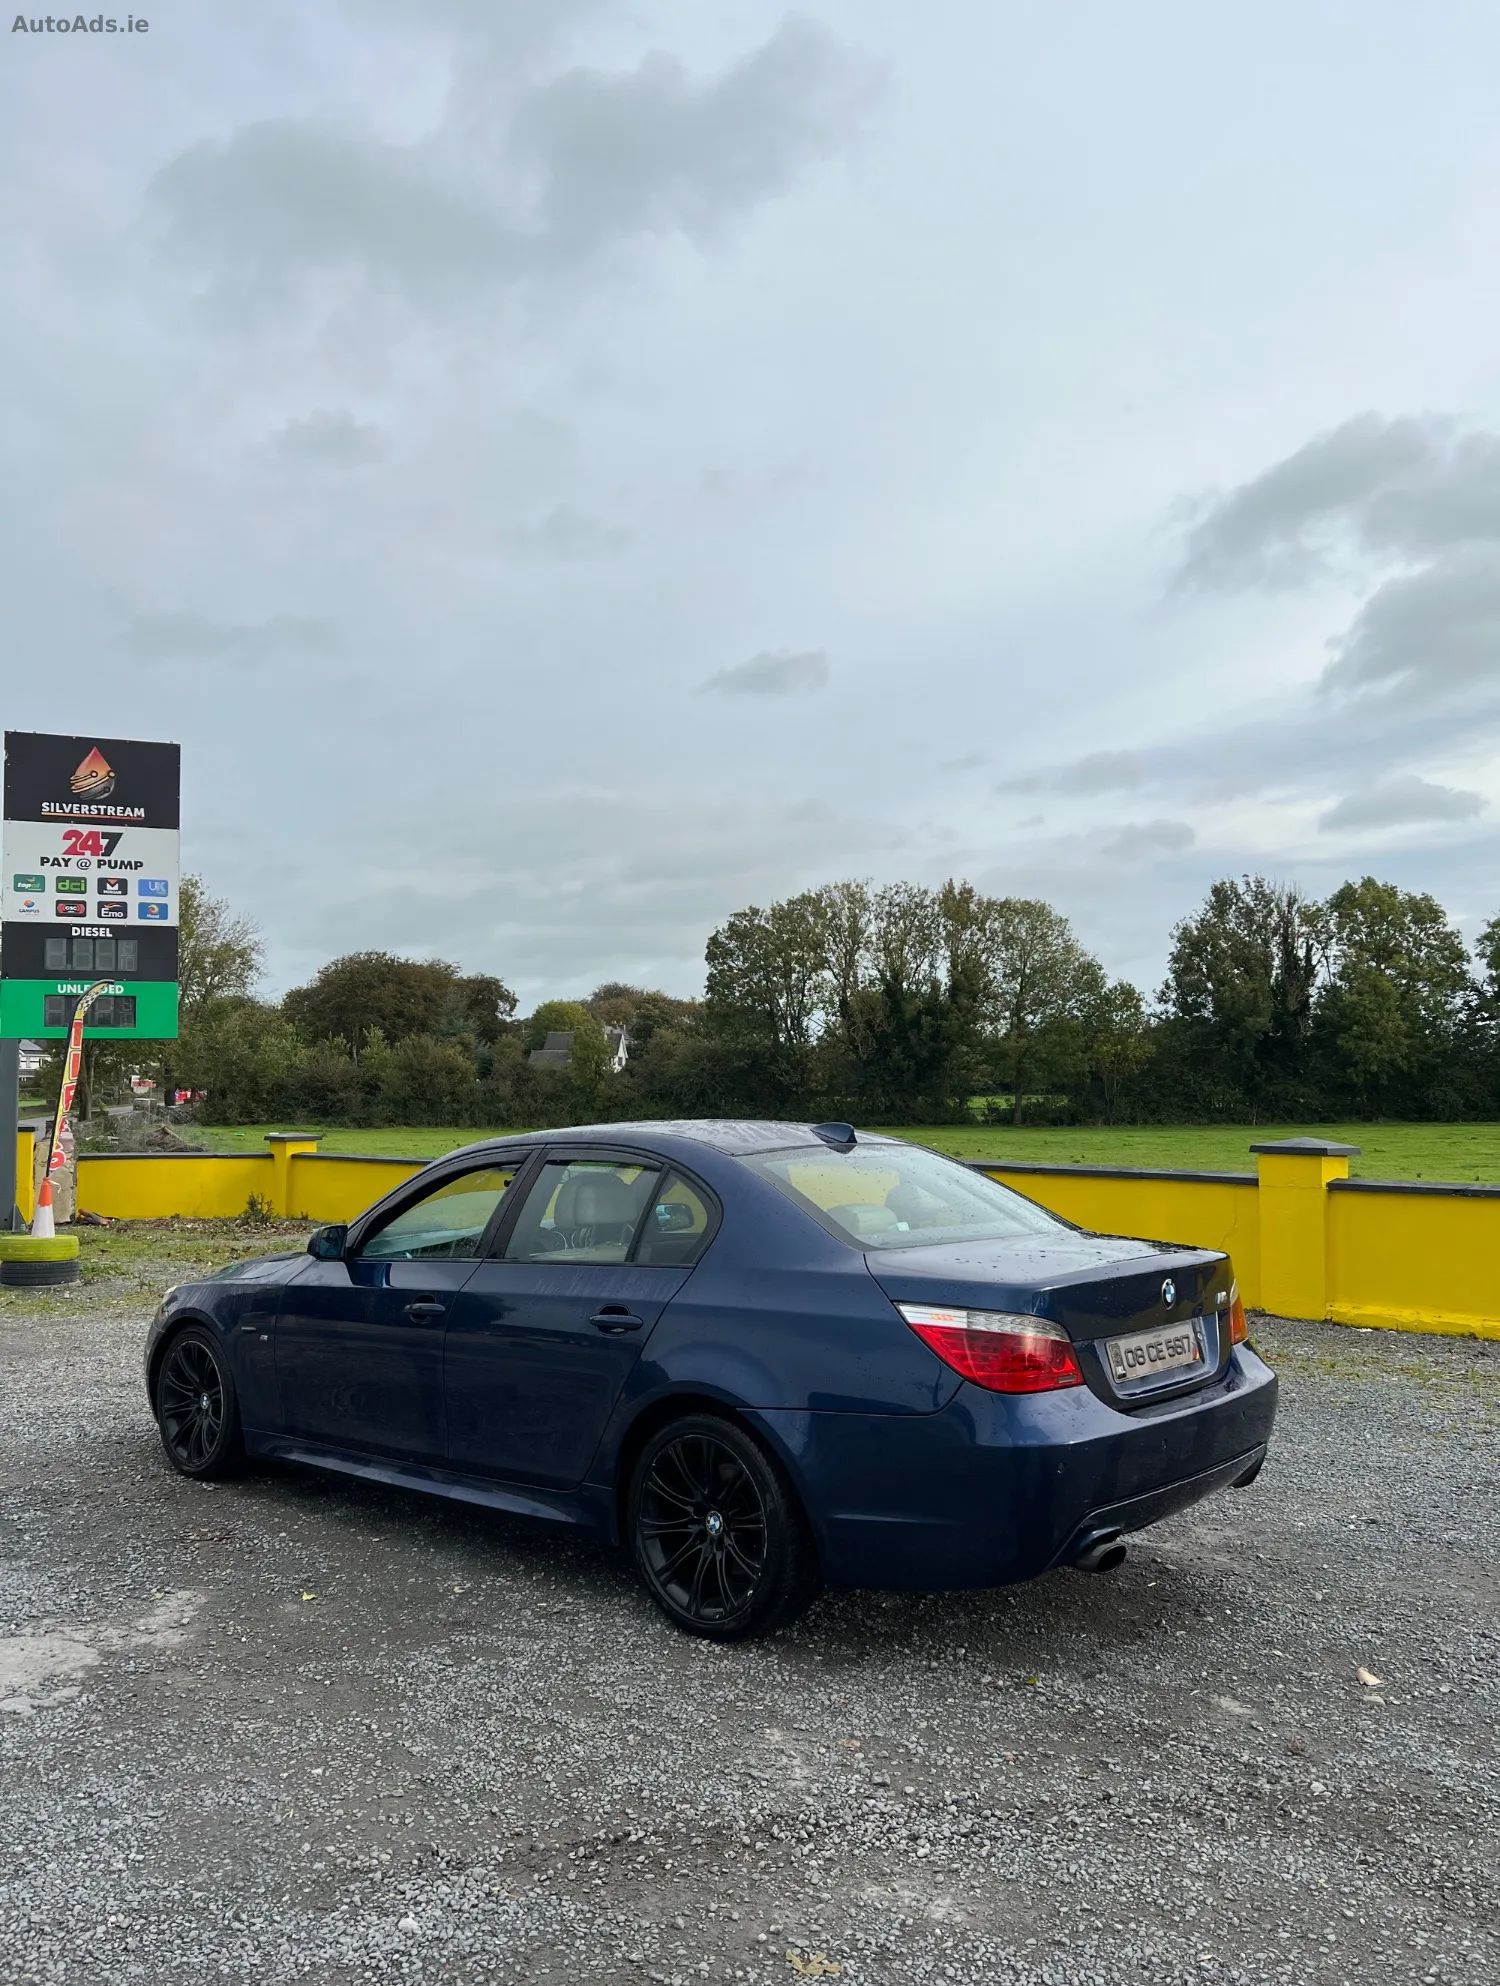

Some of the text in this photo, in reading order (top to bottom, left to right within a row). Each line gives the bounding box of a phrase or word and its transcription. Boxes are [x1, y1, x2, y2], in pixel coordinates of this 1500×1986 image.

[41, 802, 145, 817] SILVERSTREAM
[62, 829, 123, 857] 247
[40, 856, 143, 871] PAY @ PUMP
[58, 880, 85, 891] dci
[148, 882, 166, 892] UK
[101, 908, 124, 918] Emo
[71, 926, 113, 937] DIESEL
[57, 984, 124, 994] UNLEDED
[1125, 1346, 1146, 1367] 08
[1146, 1340, 1166, 1362] CE
